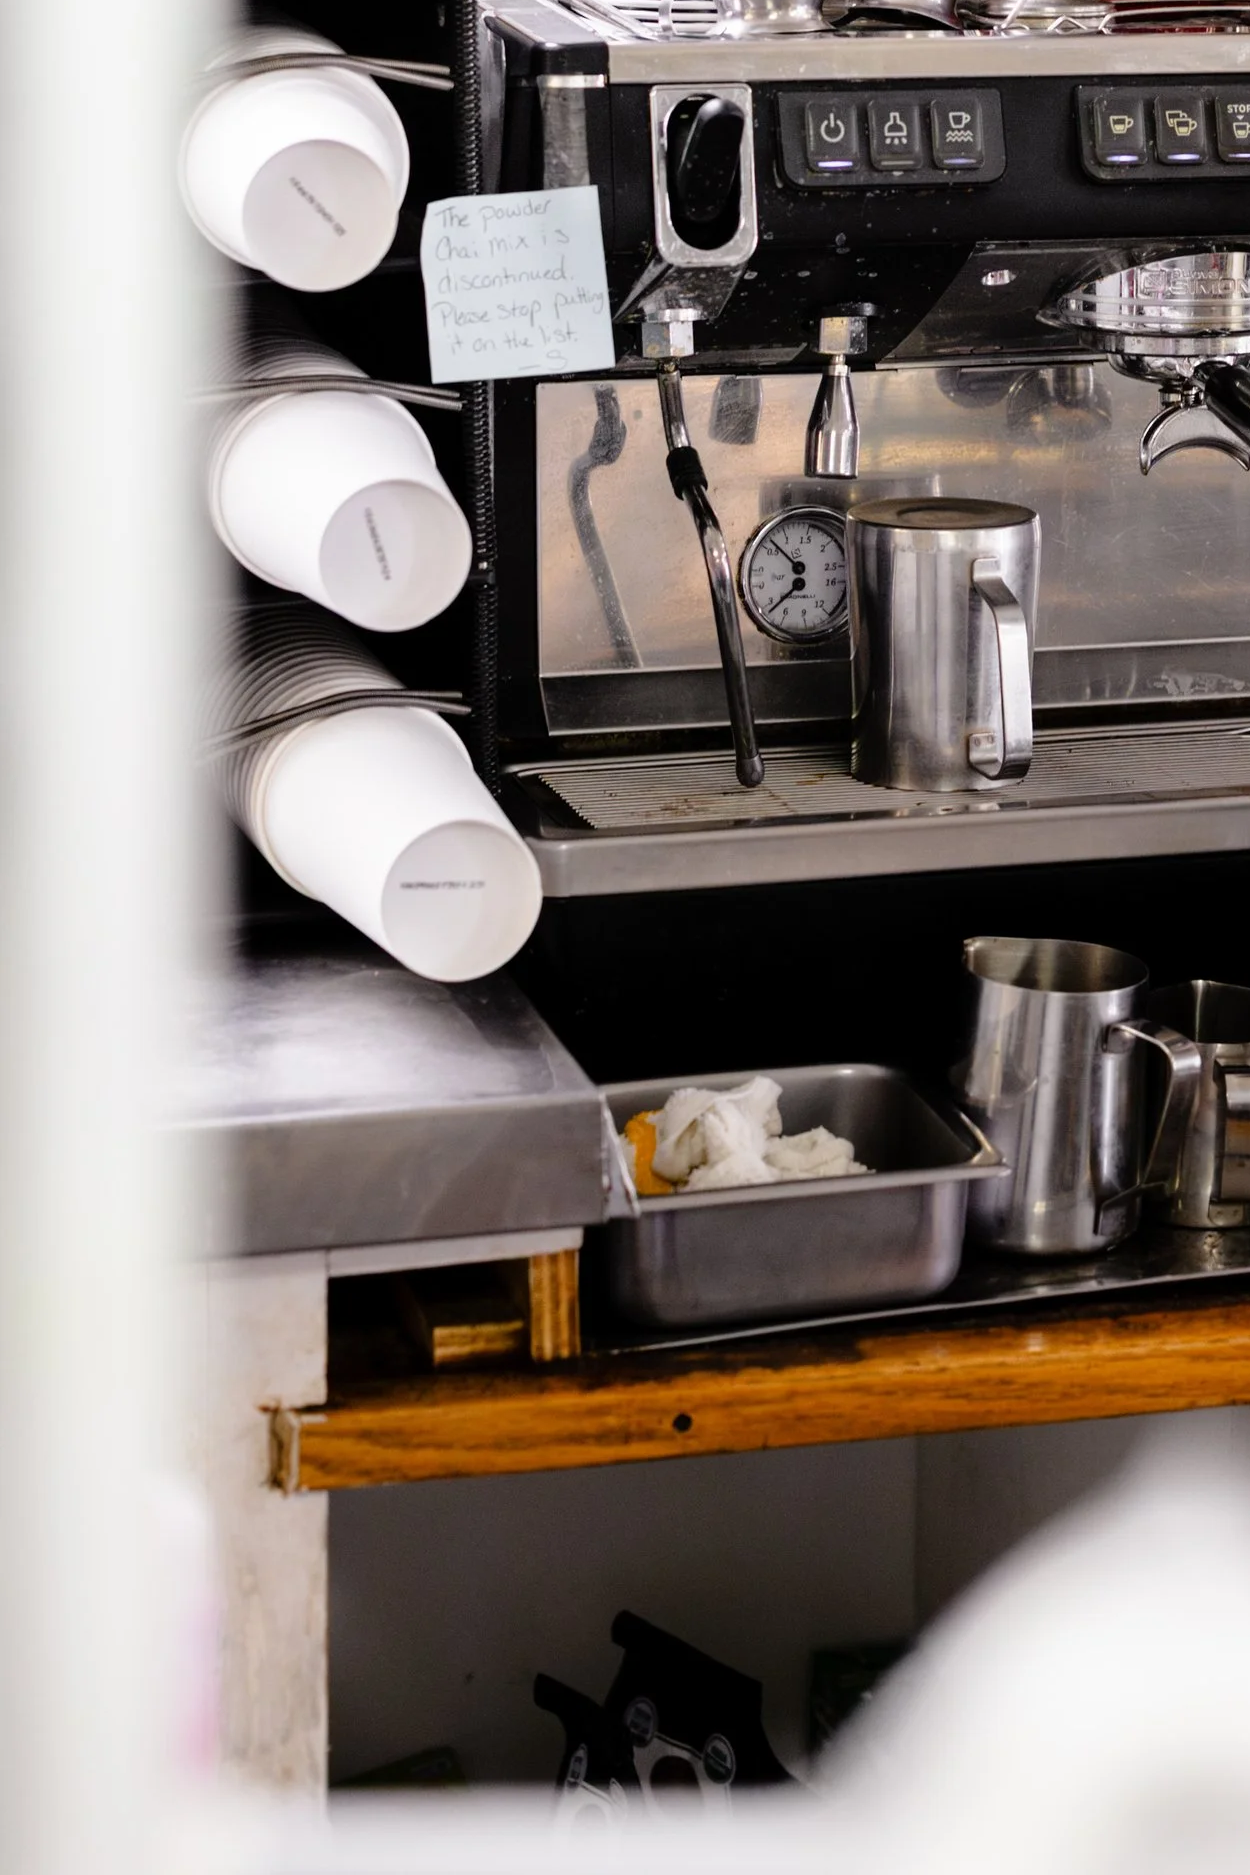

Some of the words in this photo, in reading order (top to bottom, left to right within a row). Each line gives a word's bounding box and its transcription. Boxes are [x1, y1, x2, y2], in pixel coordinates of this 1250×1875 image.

[434, 206, 470, 229] The
[479, 199, 553, 233] powder
[541, 225, 571, 245] is
[431, 300, 491, 327] Please
[554, 286, 605, 320] putting
[450, 331, 463, 355] it
[472, 337, 497, 353] on
[504, 331, 534, 349] the
[799, 536, 812, 544] 1.5
[766, 548, 780, 556] 0.5
[820, 545, 826, 553] 2
[824, 563, 838, 571] 2.5
[825, 577, 837, 586] 16
[767, 597, 774, 605] 3
[815, 600, 825, 609] 12
[783, 607, 789, 615] 6
